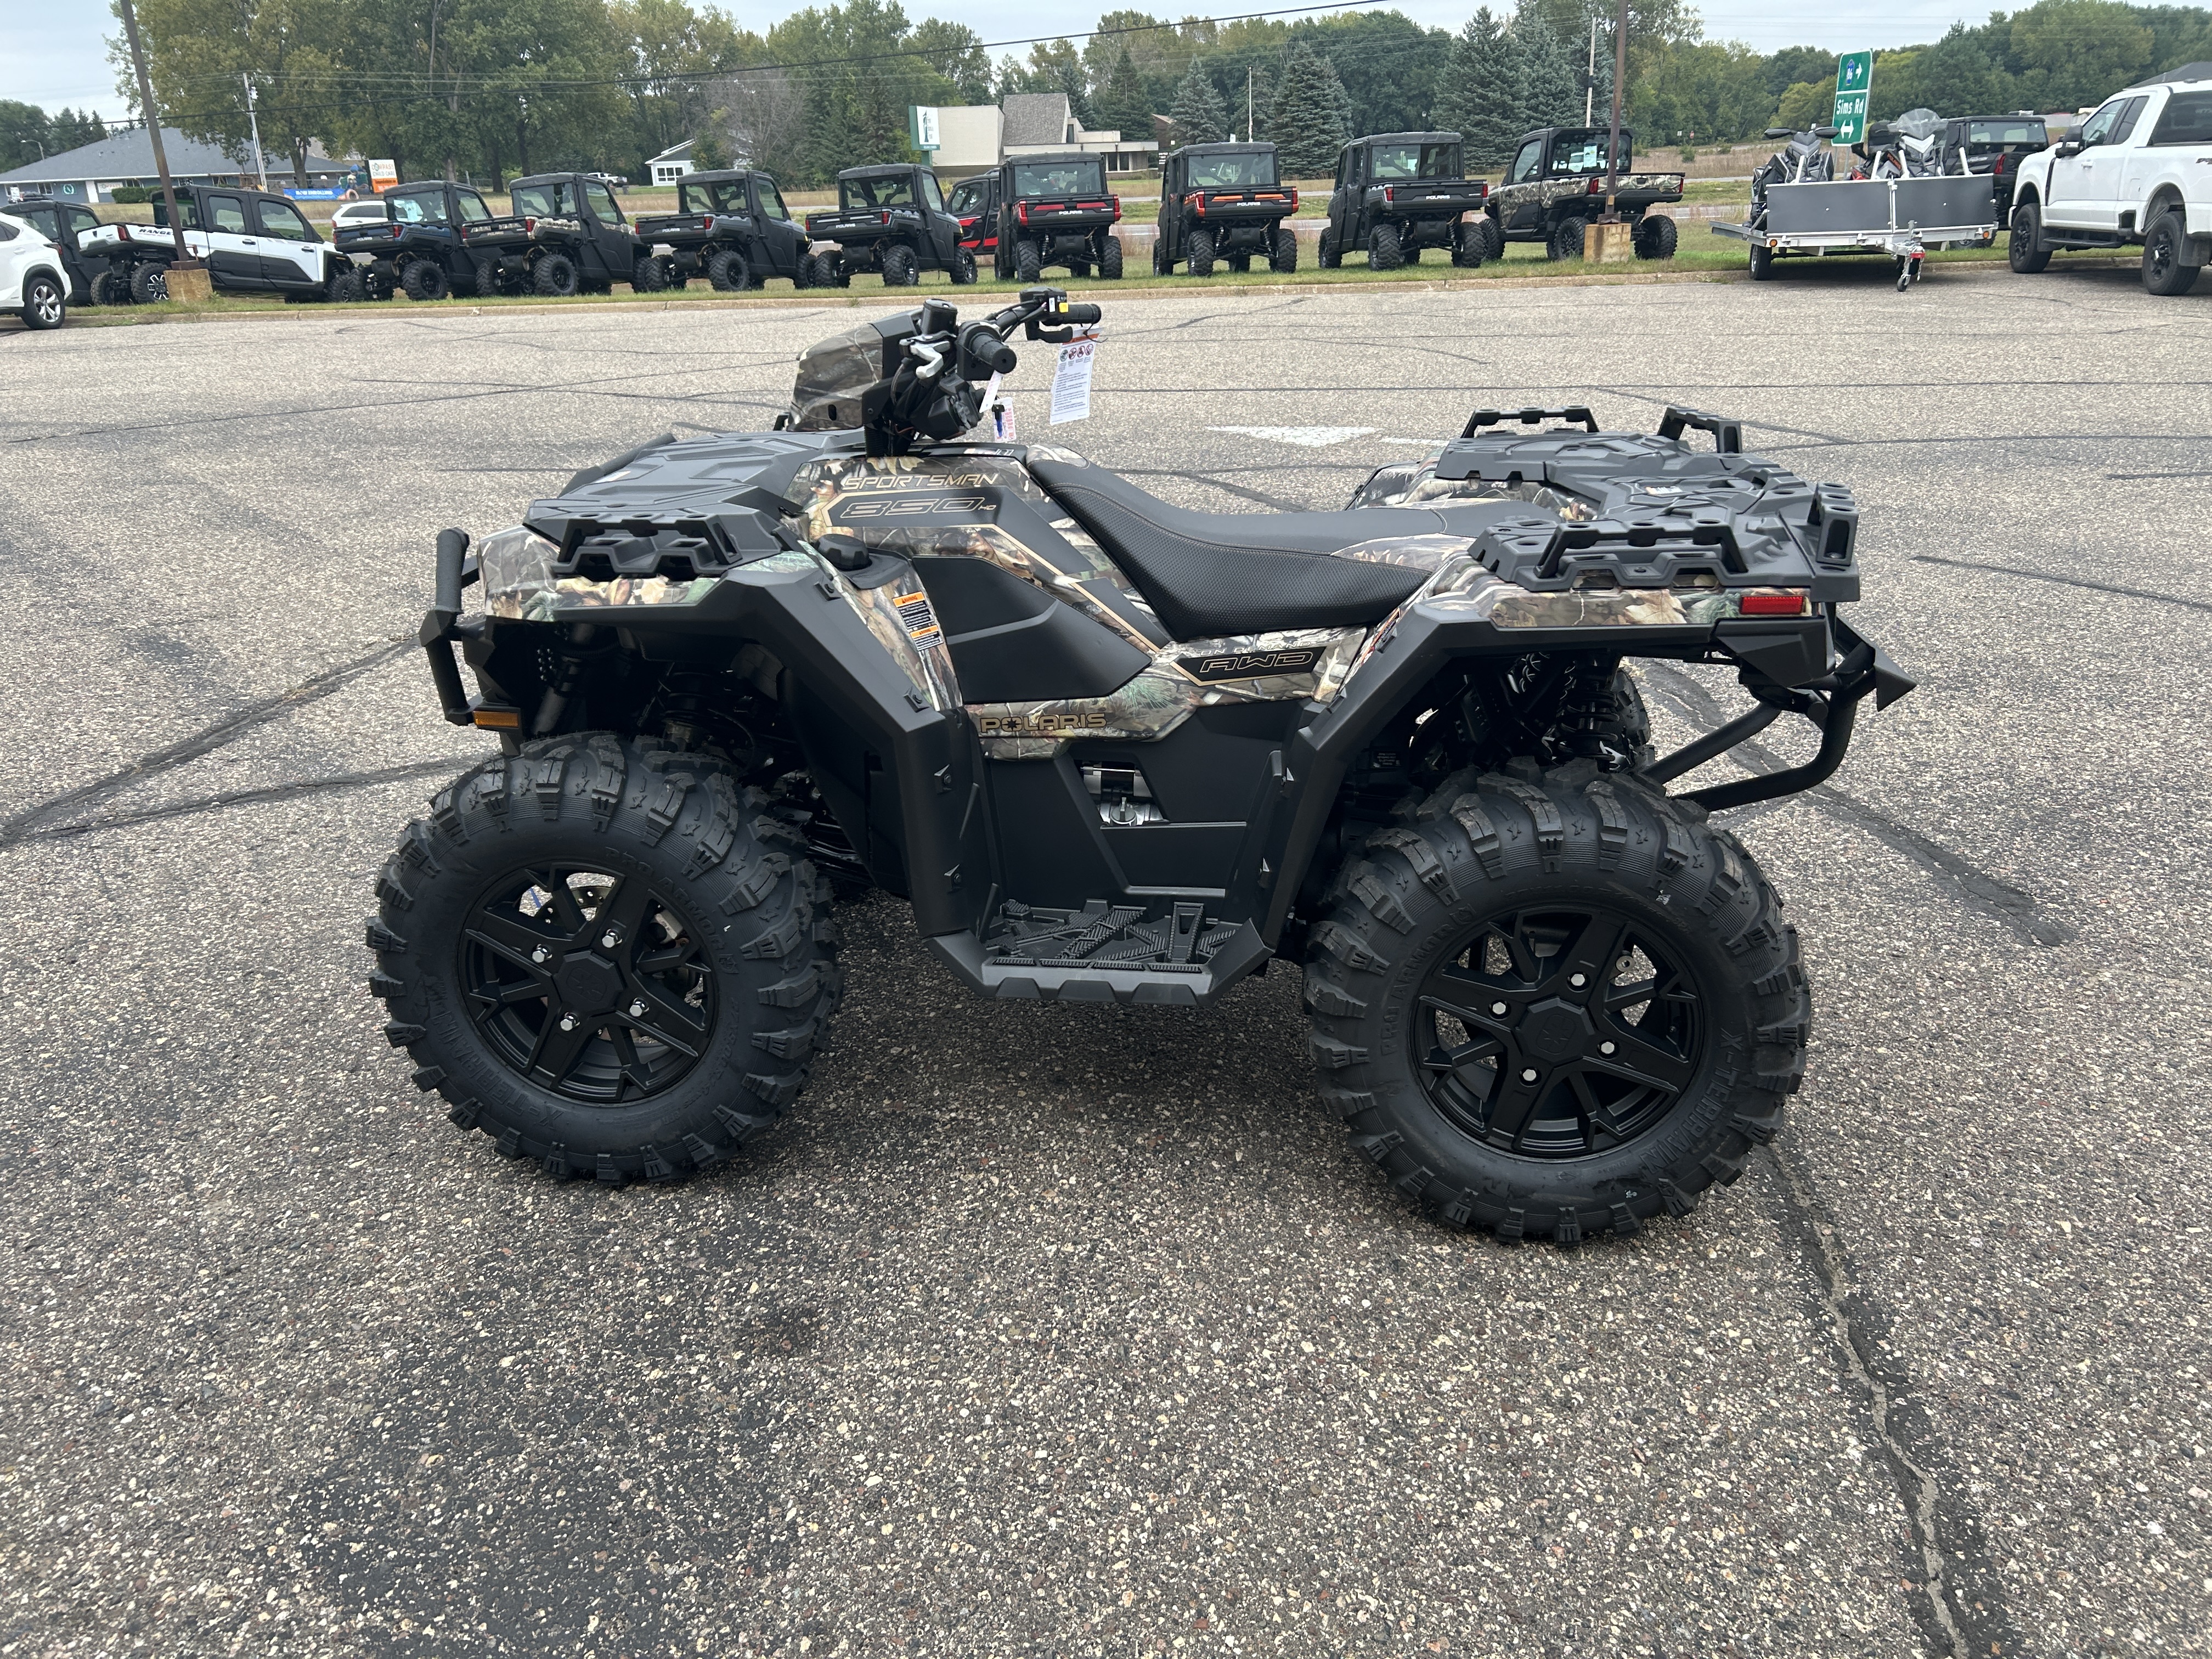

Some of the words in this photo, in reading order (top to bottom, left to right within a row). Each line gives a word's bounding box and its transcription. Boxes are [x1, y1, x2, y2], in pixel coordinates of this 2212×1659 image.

[1836, 99, 1853, 115] Sims
[1854, 98, 1865, 114] Rd
[842, 473, 998, 490] SPORTSMAN
[840, 497, 985, 518] 850
[1200, 648, 1226, 656] ON
[1234, 641, 1312, 653] DEMAND
[1199, 651, 1313, 673] AWD
[980, 713, 1107, 733] POLARIS
[605, 846, 654, 876] PRO
[657, 876, 727, 950] ARMOR
[1390, 923, 1457, 1002] ARMOR
[1380, 1004, 1402, 1058] PRO
[431, 1009, 564, 1131] X-TERRAIN
[1639, 1027, 1747, 1175] X-TERRAIN
